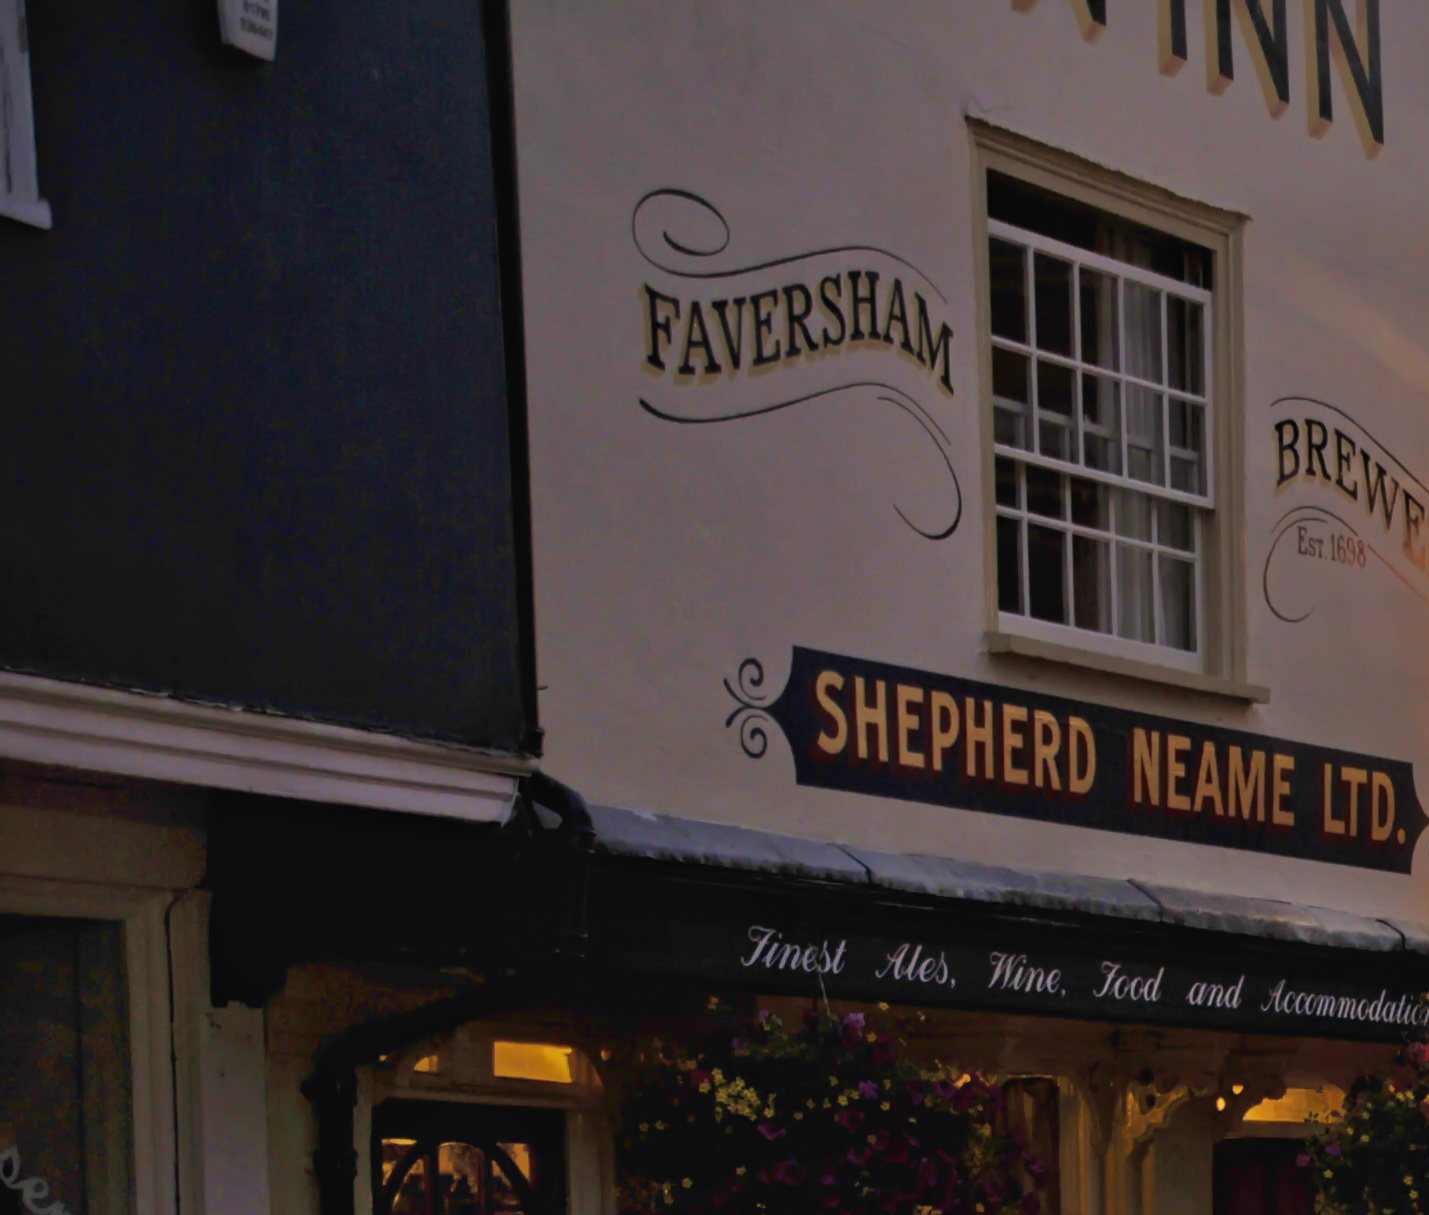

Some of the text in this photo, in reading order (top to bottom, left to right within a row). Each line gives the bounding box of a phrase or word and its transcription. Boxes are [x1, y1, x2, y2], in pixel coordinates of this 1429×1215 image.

[642, 269, 955, 397] FAVERSHAM
[1331, 529, 1367, 568] 1698
[813, 670, 1408, 846] SHEPHERD NEAME LTD.
[739, 925, 846, 976] Finest
[874, 943, 957, 990] Ales,
[987, 950, 1067, 998] Wine,
[1092, 960, 1163, 1006] Food
[1187, 974, 1243, 1013] and
